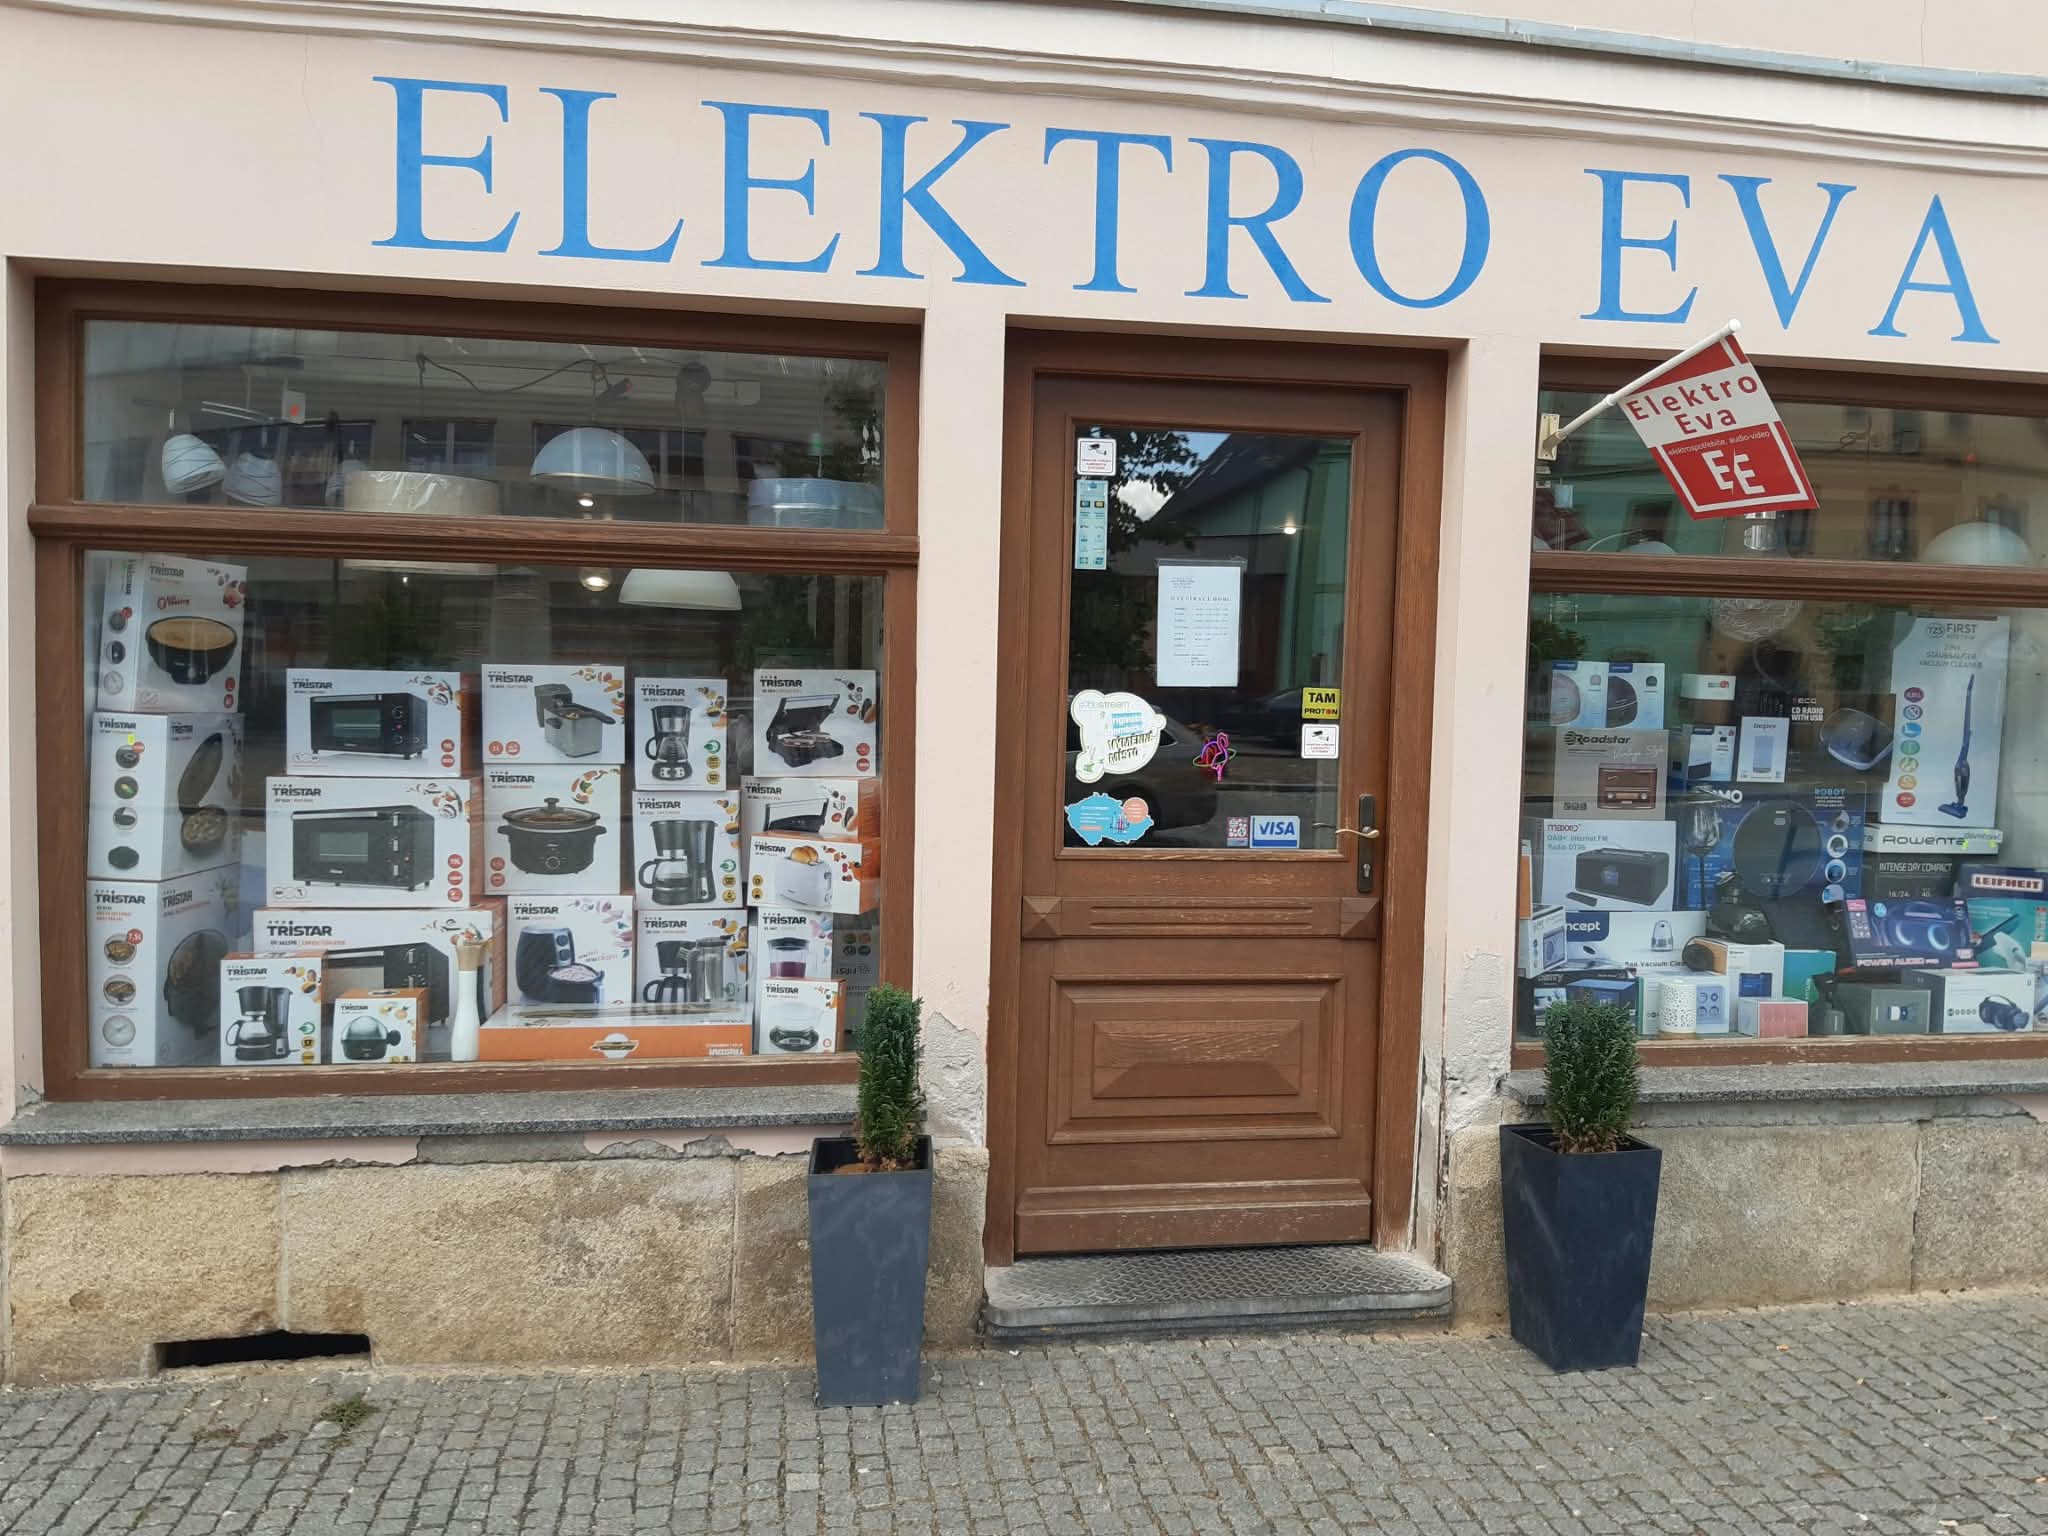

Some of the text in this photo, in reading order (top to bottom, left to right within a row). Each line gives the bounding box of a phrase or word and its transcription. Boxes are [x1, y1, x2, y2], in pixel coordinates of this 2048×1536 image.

[372, 77, 2000, 345] ELEKTRO EVA
[1625, 375, 1758, 421] Elektro
[1674, 409, 1737, 435] Eva
[1946, 623, 1977, 634] FIRST
[488, 673, 534, 683] TRISTAR
[760, 677, 803, 687] TRISTAR
[292, 680, 333, 689] TRISTAR
[640, 685, 686, 697] TRISTAR
[1308, 692, 1336, 703] TAM
[1304, 707, 1338, 715] PROTON
[99, 720, 137, 730] TRISTAR
[1575, 733, 1632, 746] Roadstar
[490, 773, 535, 783] TRISTAR
[272, 785, 322, 797] TRISTAR
[745, 785, 783, 795] TRISTAR
[1814, 788, 1847, 796] ROBOT
[637, 799, 682, 809] TRISTAR
[1259, 821, 1296, 836] VISA
[754, 845, 787, 854] TRISTAR
[1975, 876, 2041, 889] LEIFHEIT
[94, 891, 146, 904] TRISTAR
[514, 905, 560, 914] TRISTAR
[643, 919, 688, 929] TRISTAR
[762, 914, 808, 925] TRISTAR
[267, 921, 333, 937] TRISTAR
[1565, 920, 1601, 933] ncept
[227, 966, 267, 975] TRISTAR
[766, 986, 799, 994] TRISTAR
